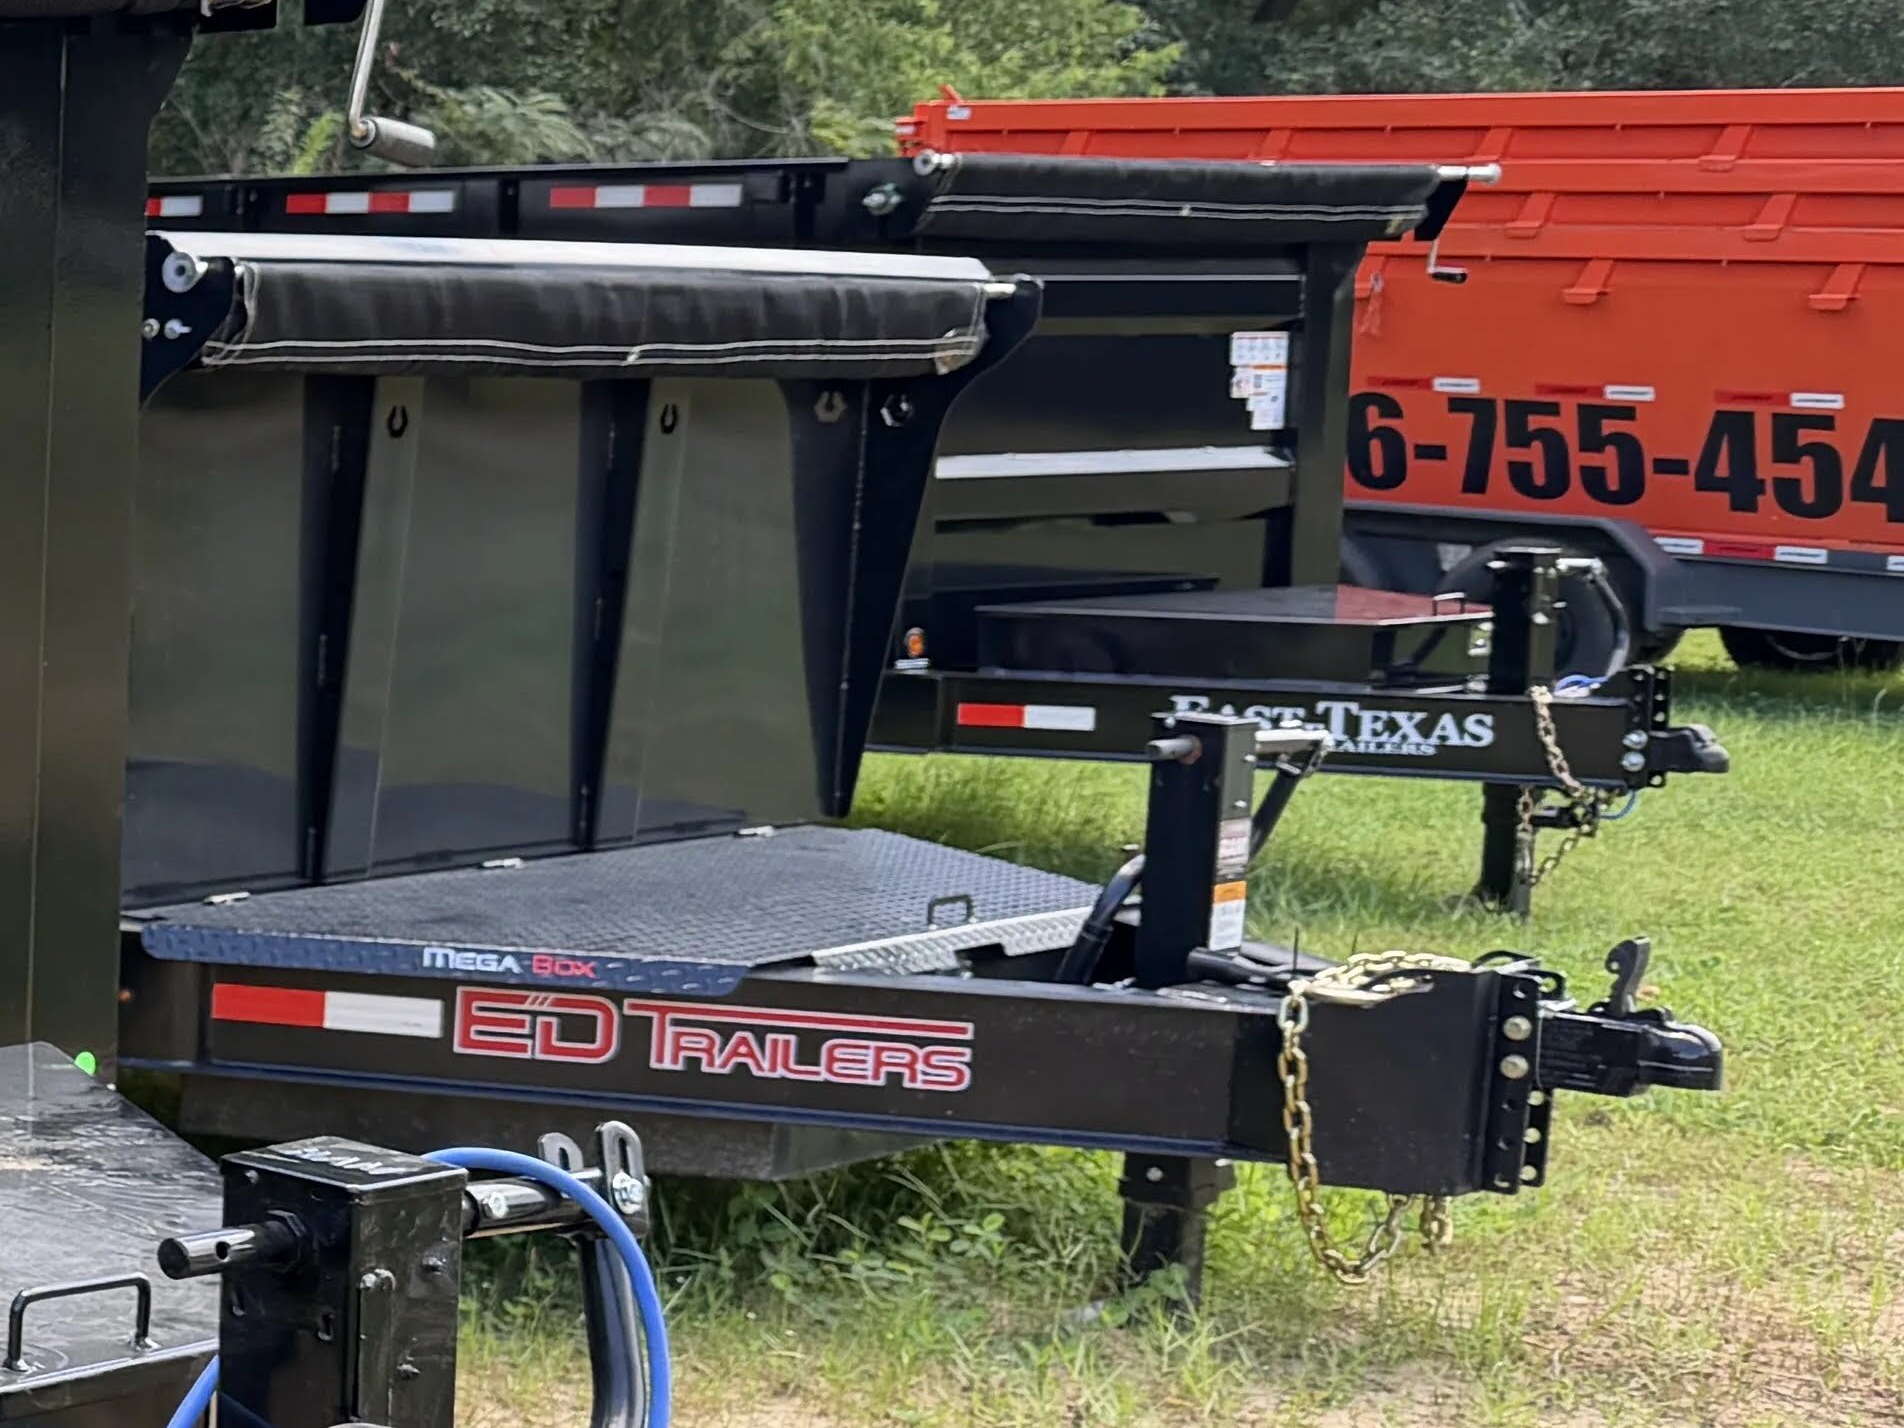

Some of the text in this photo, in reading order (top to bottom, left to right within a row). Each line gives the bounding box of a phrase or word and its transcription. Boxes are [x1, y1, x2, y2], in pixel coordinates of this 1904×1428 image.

[1346, 391, 1904, 524] 6-755-454
[1315, 700, 1495, 748] TEXAS
[422, 946, 522, 974] MEGA
[452, 985, 975, 1092] ED TRAILERS
